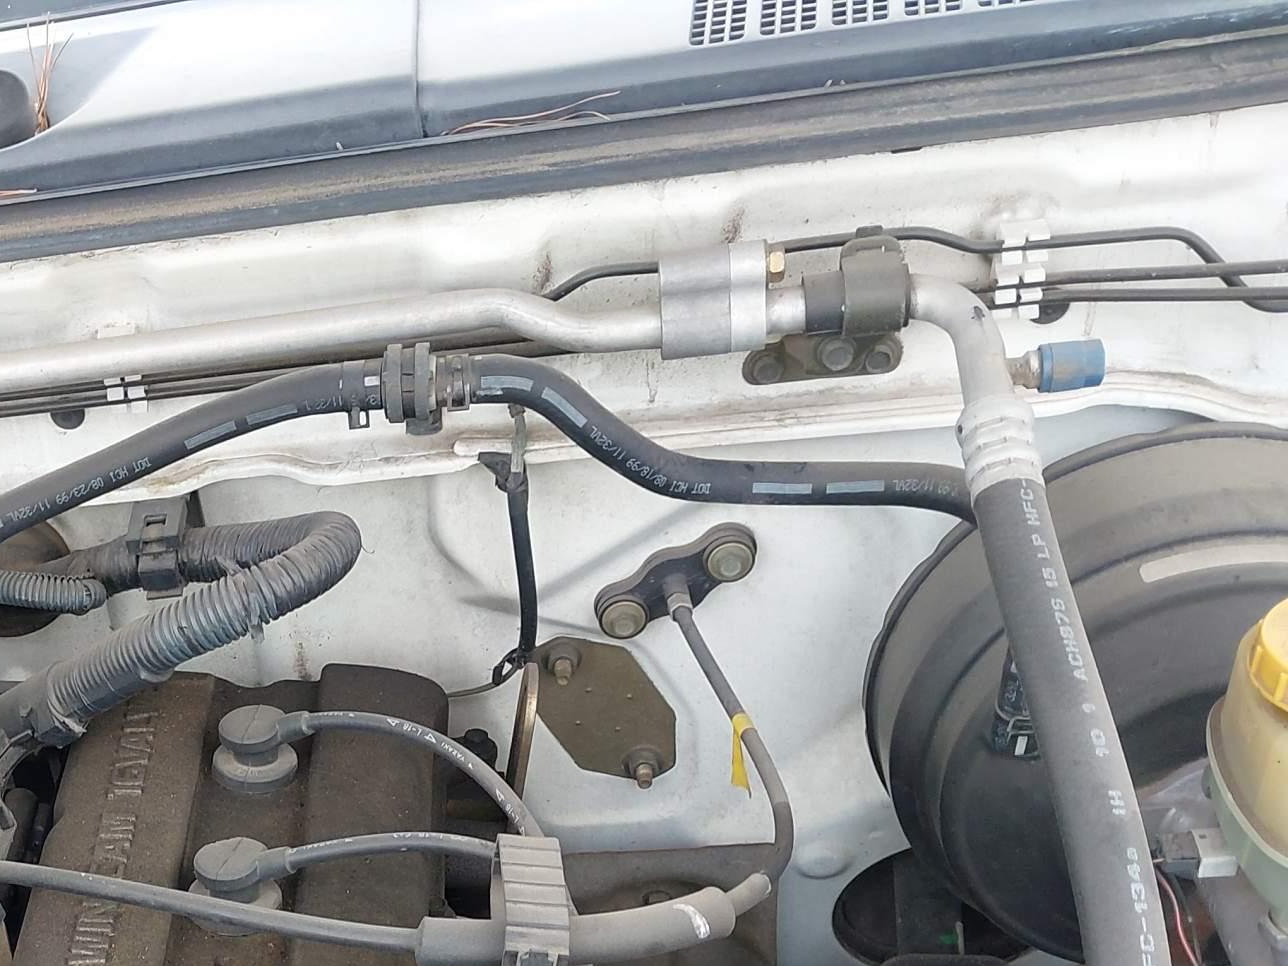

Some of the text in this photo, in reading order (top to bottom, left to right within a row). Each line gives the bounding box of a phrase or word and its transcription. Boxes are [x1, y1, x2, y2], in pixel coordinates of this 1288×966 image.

[590, 425, 627, 460] 11/32VL
[132, 456, 153, 474] DOT
[56, 476, 105, 505] 08/23/99
[691, 482, 712, 494] DOT
[7, 497, 52, 522] 11/32VL
[1020, 479, 1042, 526] HFC-
[1032, 533, 1050, 560] LP
